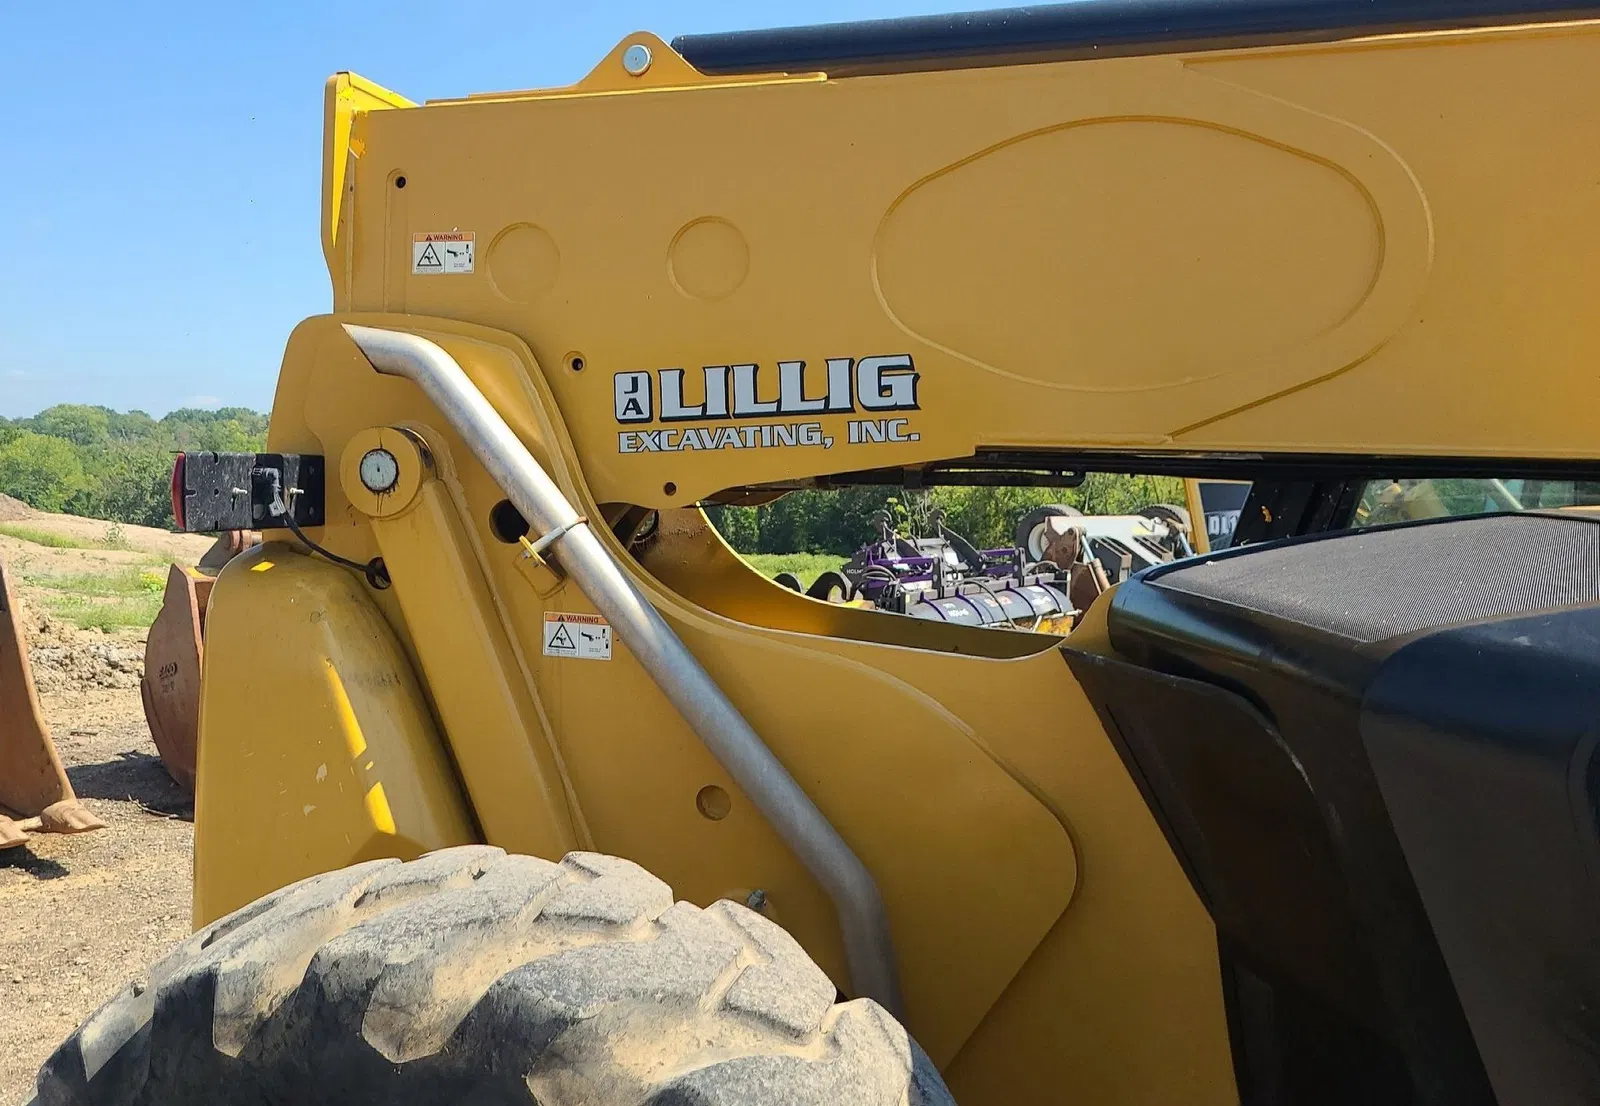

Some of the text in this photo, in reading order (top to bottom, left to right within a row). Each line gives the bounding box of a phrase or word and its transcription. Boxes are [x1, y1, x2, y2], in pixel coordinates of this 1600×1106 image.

[433, 233, 463, 241] WARNING
[657, 354, 921, 421] LILLIG
[618, 418, 921, 453] EXCAVATING, INC.
[566, 615, 599, 624] WARNING
